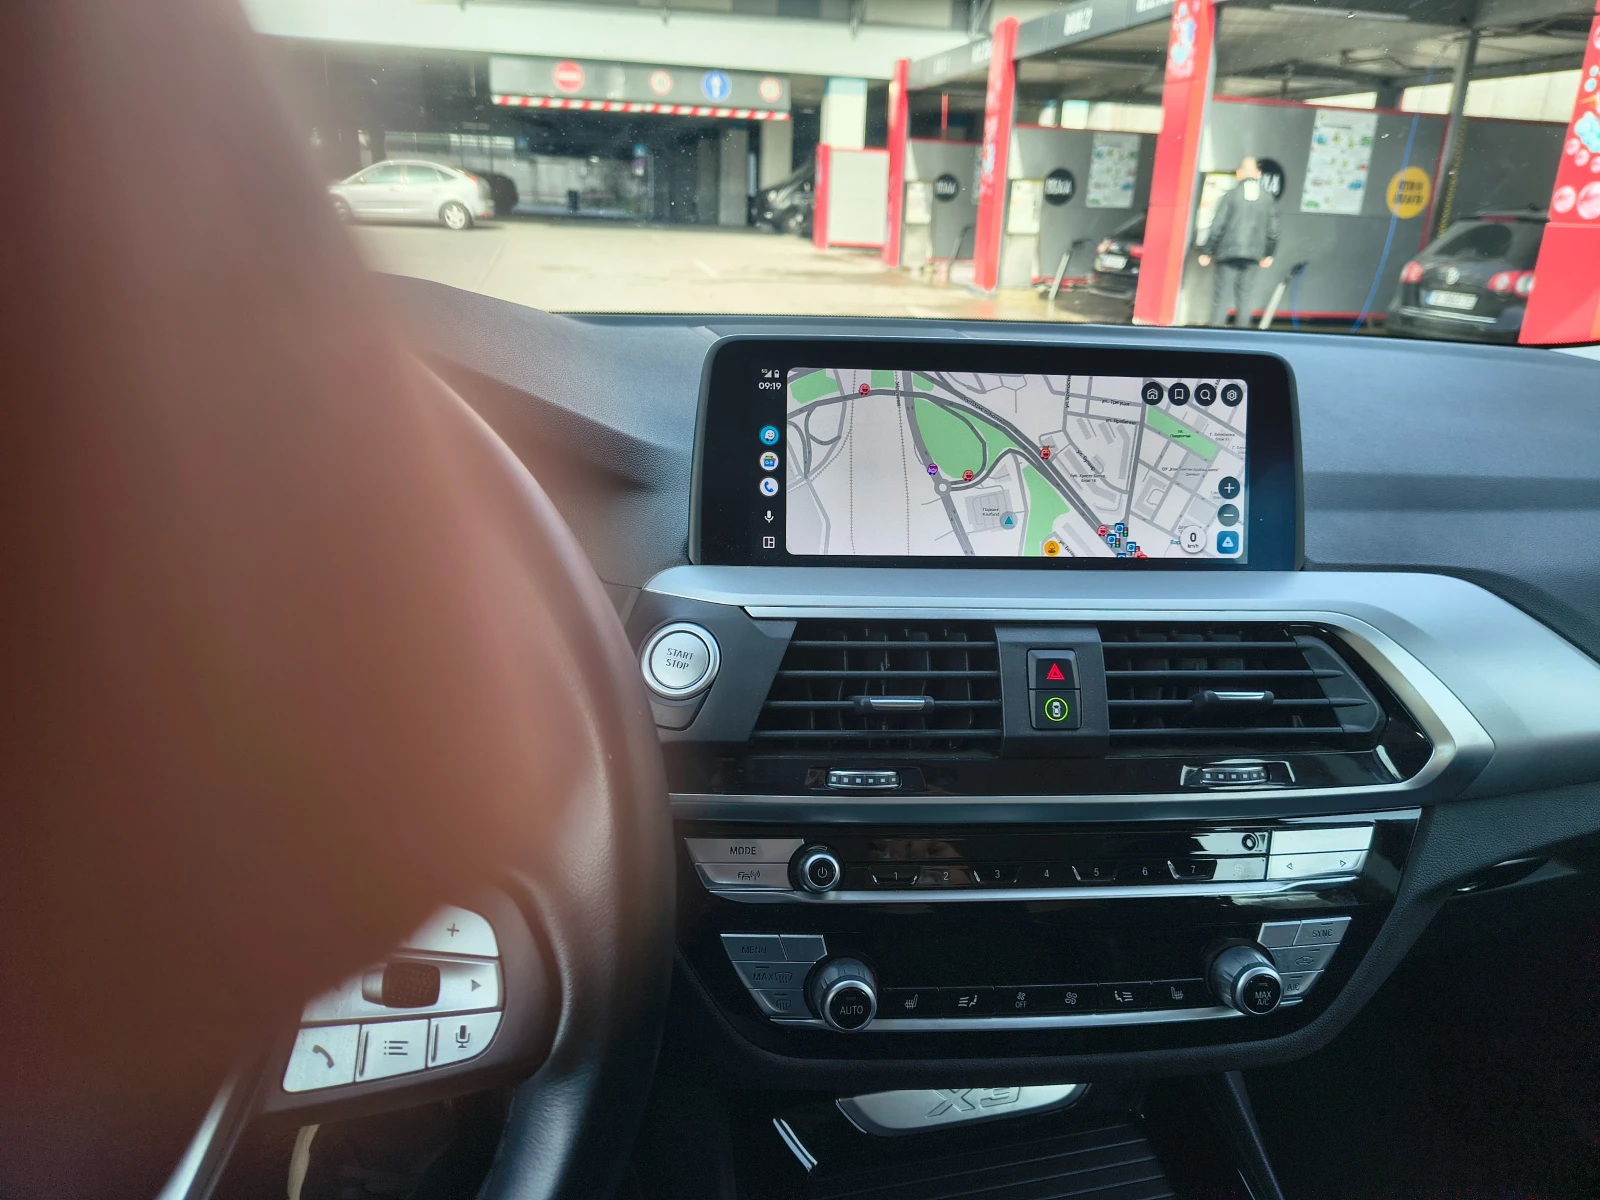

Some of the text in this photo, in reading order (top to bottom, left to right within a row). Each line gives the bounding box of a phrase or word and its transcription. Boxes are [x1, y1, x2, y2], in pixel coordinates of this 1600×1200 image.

[758, 382, 782, 390] 09:19
[1189, 532, 1197, 542] 0
[666, 647, 694, 660] START
[665, 659, 690, 670] STOP
[729, 845, 757, 856] MODE
[994, 869, 1001, 879] 3
[1043, 869, 1050, 879] 4
[1093, 867, 1099, 877] 5
[1142, 866, 1148, 876] 6
[1190, 865, 1196, 875] 7
[893, 871, 899, 881] 1
[943, 871, 949, 881] 2
[1312, 928, 1333, 938] SYNC
[741, 944, 767, 954] MENU
[753, 972, 774, 982] MAX
[1254, 990, 1272, 999] MAX
[1015, 1000, 1028, 1009] OFF
[1256, 998, 1270, 1006] A/C
[839, 1004, 864, 1015] AUTO
[925, 1086, 1022, 1118] X3
